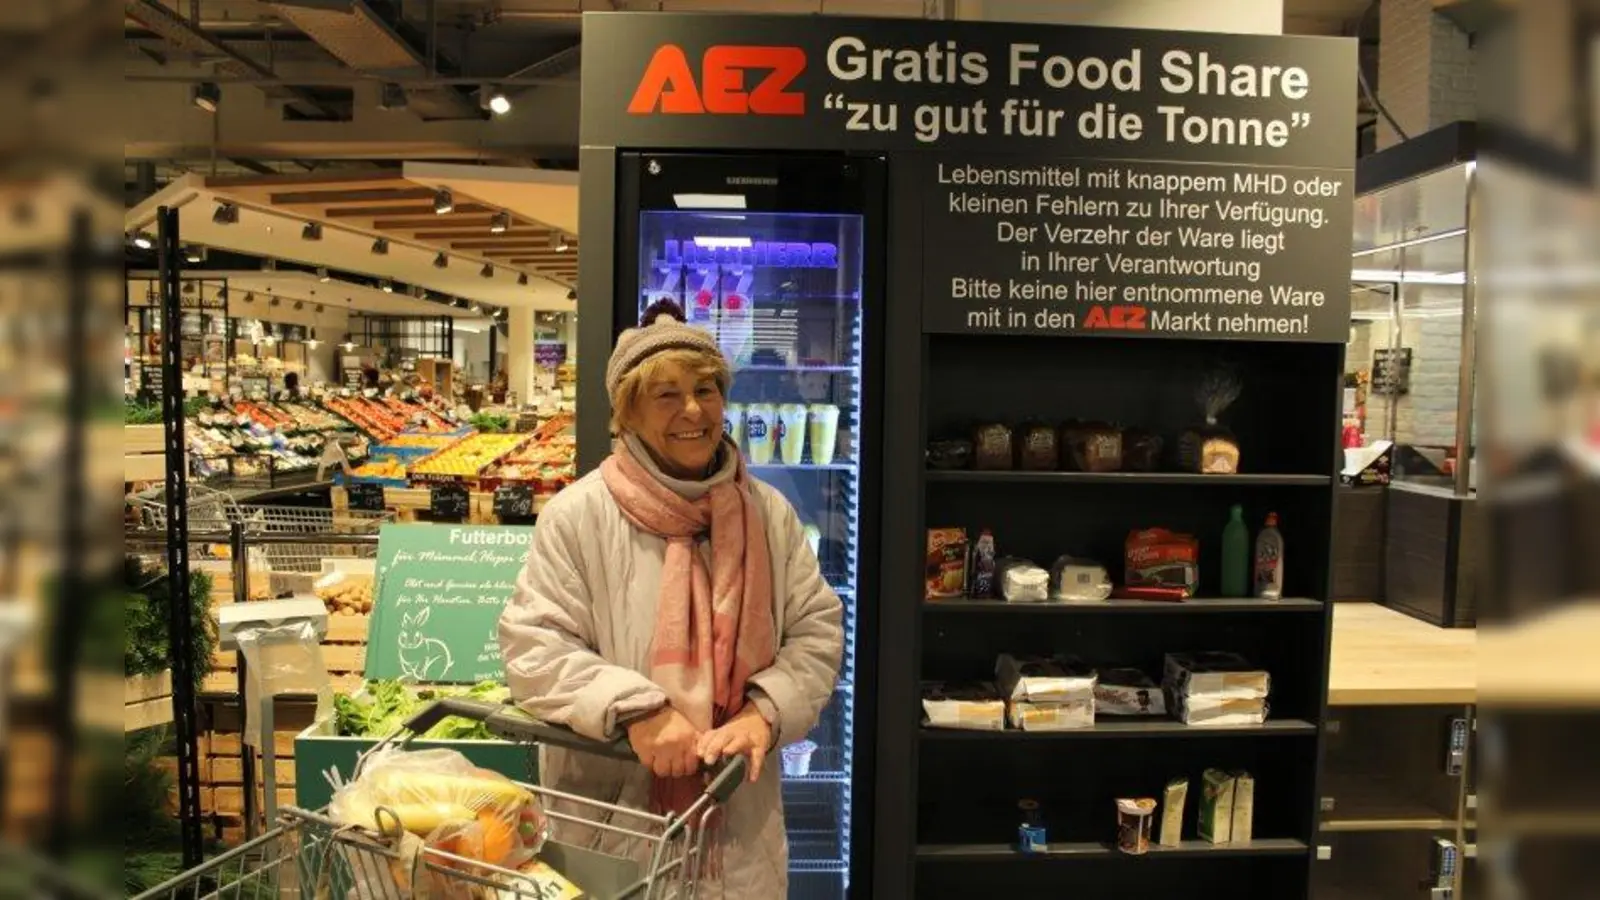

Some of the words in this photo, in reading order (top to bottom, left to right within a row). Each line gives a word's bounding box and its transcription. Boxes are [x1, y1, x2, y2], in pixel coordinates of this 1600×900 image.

[627, 43, 806, 116] AEZ
[826, 36, 988, 84] Gratis
[1010, 44, 1141, 92] Food
[1159, 49, 1309, 99] Share
[914, 100, 987, 142] gut
[1001, 100, 1065, 137] für
[1078, 103, 1143, 141] die
[939, 164, 1080, 187] Lebensmittel
[1087, 168, 1121, 188] mit
[1127, 169, 1227, 196] knappem
[1233, 173, 1287, 195] MHD
[1293, 175, 1341, 198] oder
[950, 193, 1028, 214] kleinen
[1036, 195, 1119, 217] Fehlern
[1126, 201, 1152, 218] zu
[1159, 199, 1210, 219] Ihrer
[1215, 201, 1330, 229] Verfügung.
[998, 222, 1038, 242] Der
[1044, 224, 1131, 245] Verzehr
[1135, 225, 1173, 246] der
[1177, 227, 1235, 249] Ware
[1240, 228, 1286, 256] liegt
[1022, 251, 1040, 271] in
[1049, 252, 1100, 272] Ihrer
[1105, 253, 1262, 283] Verantwortung
[952, 278, 1001, 298] Bitte
[1009, 280, 1068, 300] keine
[1075, 281, 1117, 301] hier
[1122, 284, 1265, 306] entnommene
[1270, 285, 1326, 307] Ware
[968, 308, 1001, 327] mit
[1008, 308, 1026, 327] in
[1034, 308, 1075, 328] den
[1083, 306, 1147, 329] AEZ
[1151, 310, 1212, 332] Markt
[1217, 313, 1309, 334] nehmen!
